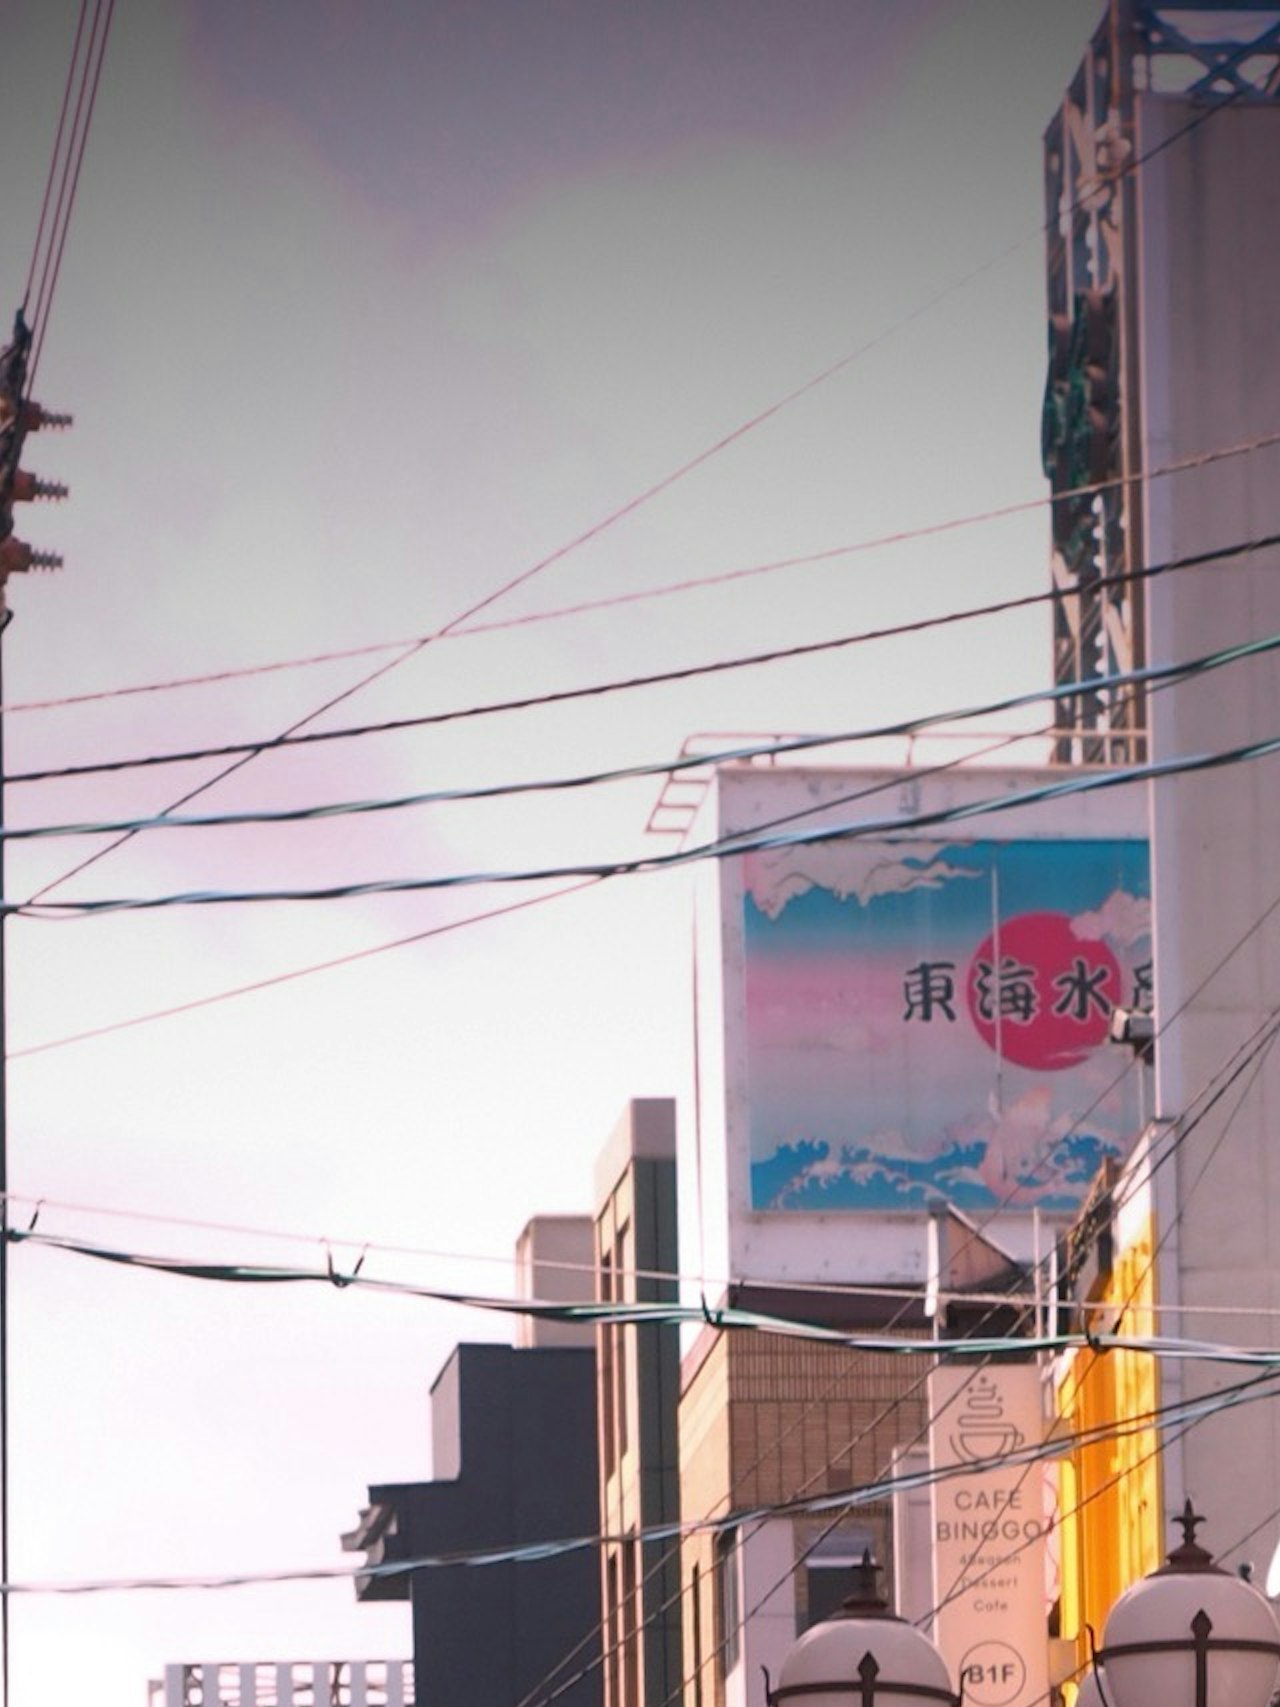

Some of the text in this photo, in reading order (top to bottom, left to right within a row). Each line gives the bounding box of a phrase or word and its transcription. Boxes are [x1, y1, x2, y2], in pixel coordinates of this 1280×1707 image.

[954, 1489, 1022, 1511] CAFE
[937, 1520, 1041, 1542] BINGGO
[963, 1576, 1019, 1590] Dessert
[973, 1599, 1008, 1612] Cafe
[968, 1662, 1014, 1684] B1F
